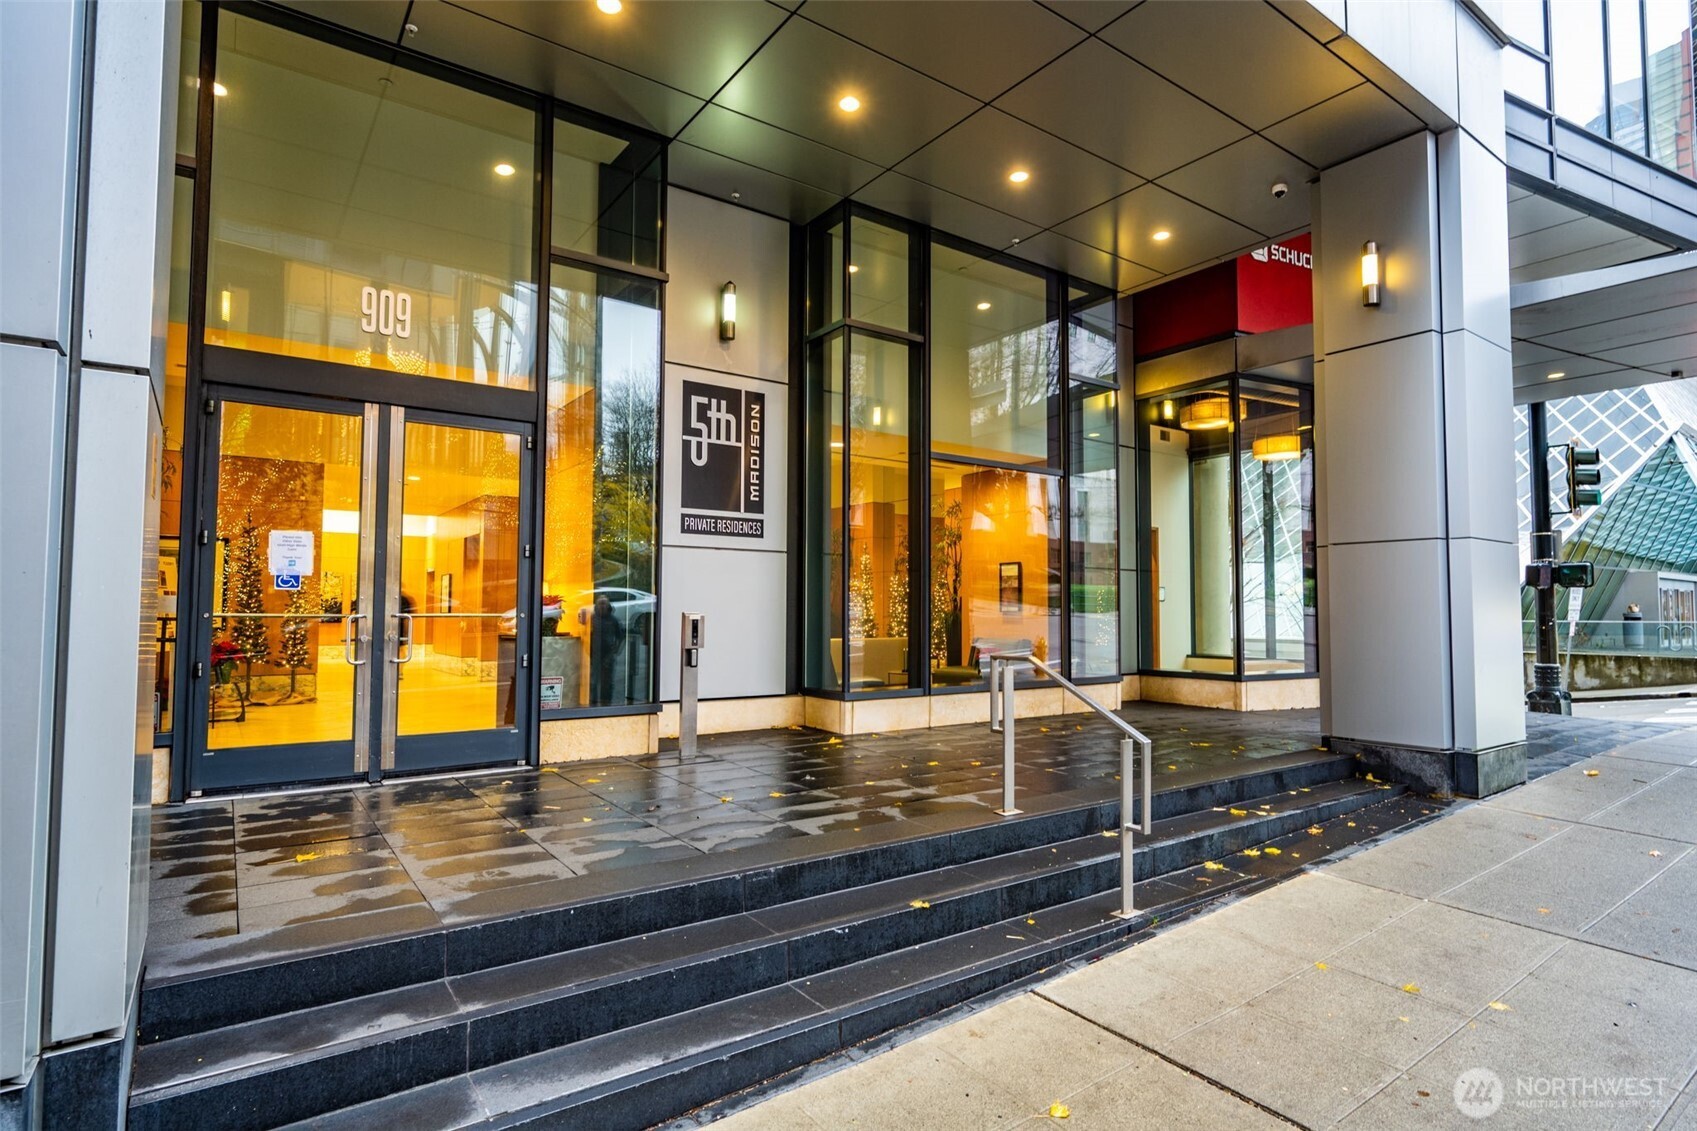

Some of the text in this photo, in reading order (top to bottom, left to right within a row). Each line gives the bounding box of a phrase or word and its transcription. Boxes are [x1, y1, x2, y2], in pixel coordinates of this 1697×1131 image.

[361, 286, 412, 339] 909
[690, 394, 737, 467] 5th
[750, 404, 760, 501] MADISON
[684, 517, 762, 535] PRIVATE RESIDENCES
